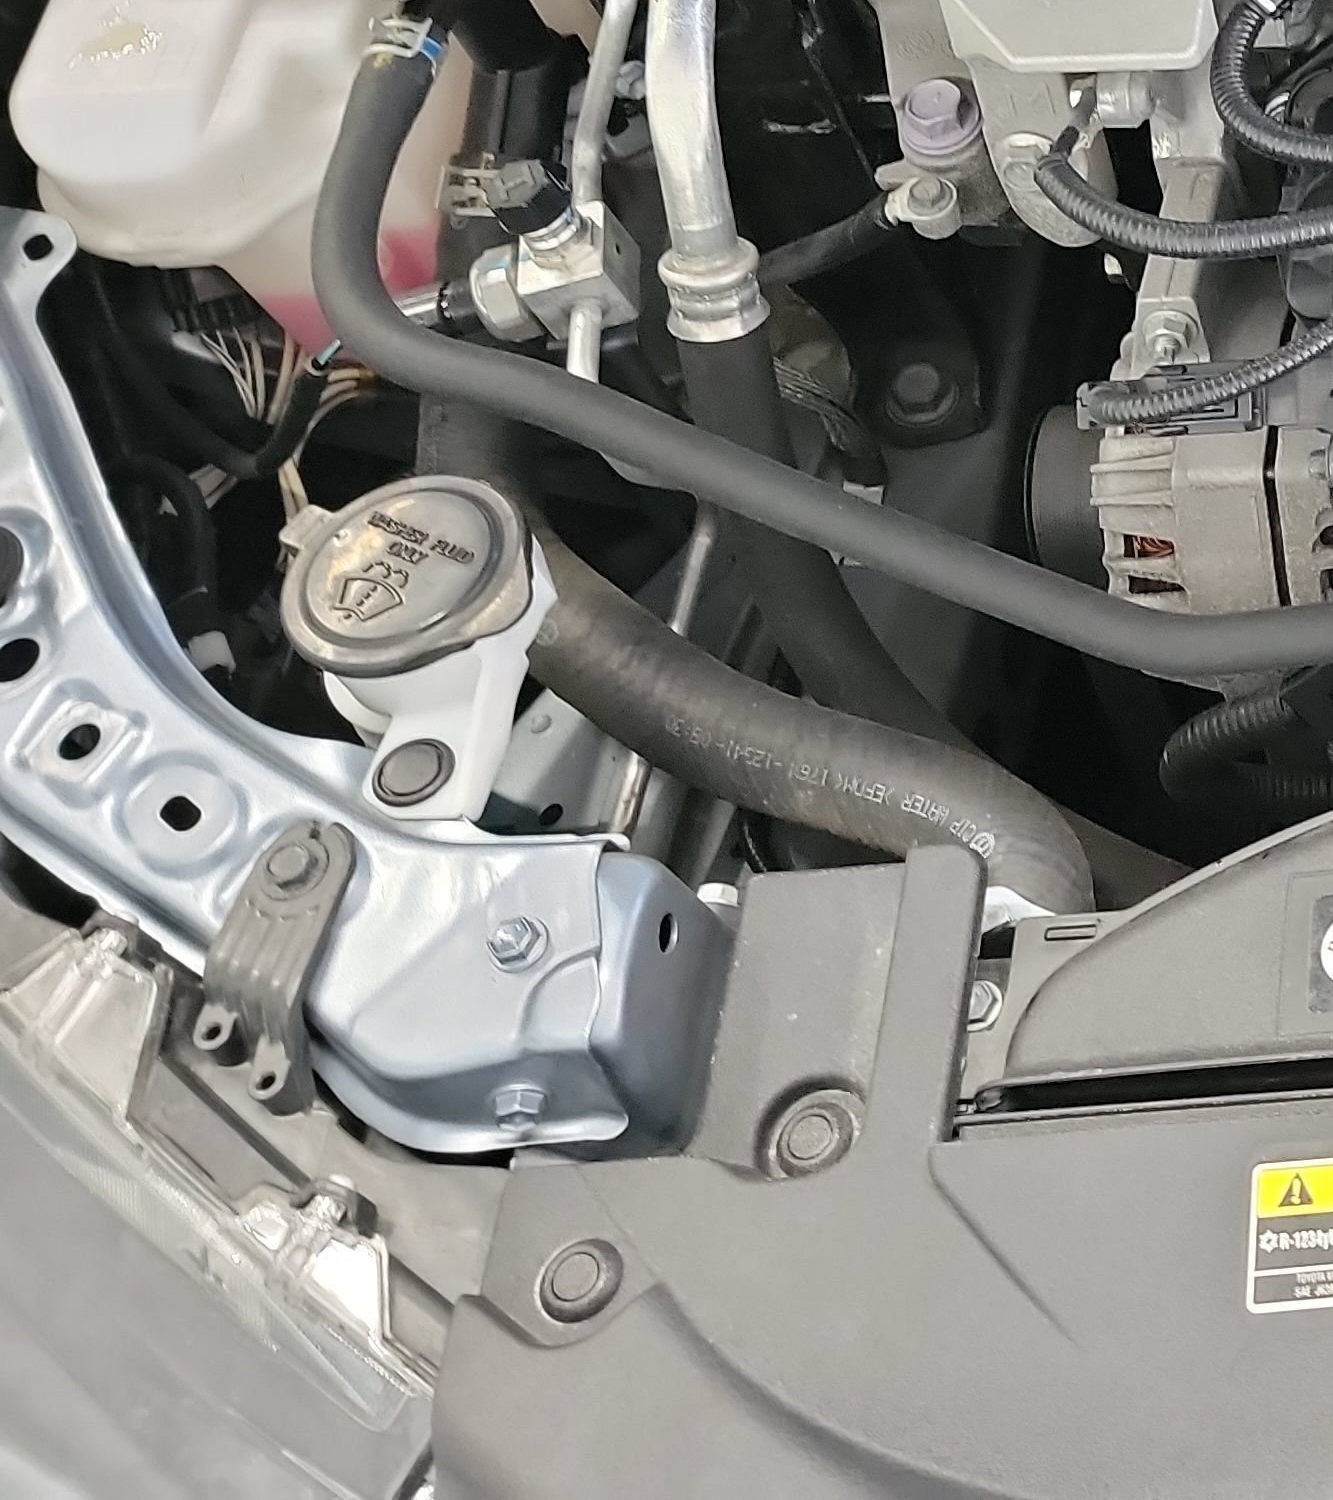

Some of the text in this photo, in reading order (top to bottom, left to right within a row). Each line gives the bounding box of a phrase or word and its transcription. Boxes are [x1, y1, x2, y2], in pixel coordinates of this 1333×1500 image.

[367, 510, 475, 565] WASHER FLUID
[387, 542, 429, 565] ONLY
[901, 792, 950, 827] WATER
